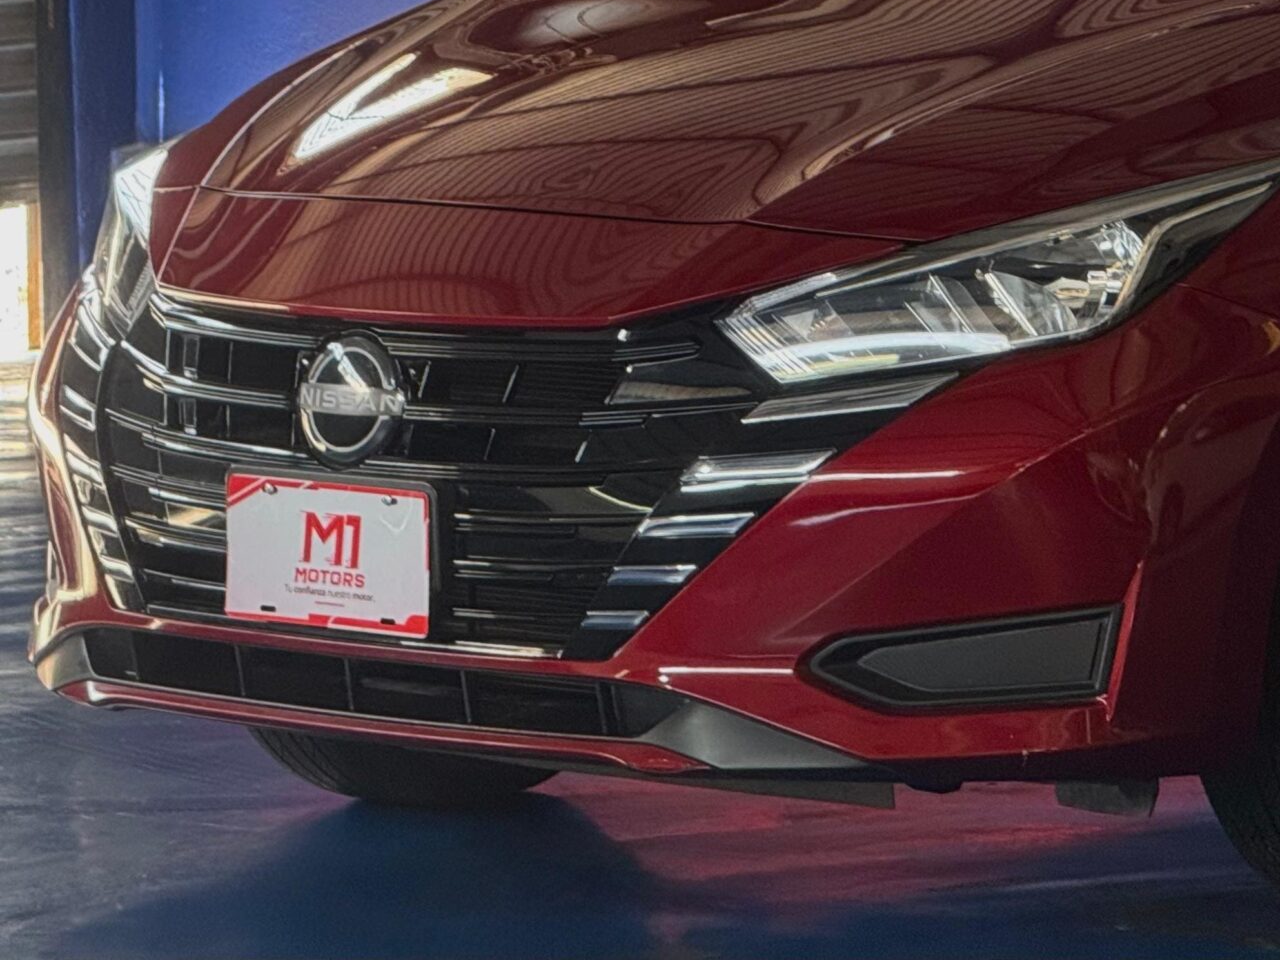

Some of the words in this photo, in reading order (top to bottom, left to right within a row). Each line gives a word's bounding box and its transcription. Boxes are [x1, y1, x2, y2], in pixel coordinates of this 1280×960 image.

[300, 386, 401, 414] NISSAN
[301, 510, 362, 569] M1
[294, 567, 366, 589] MOTORS
